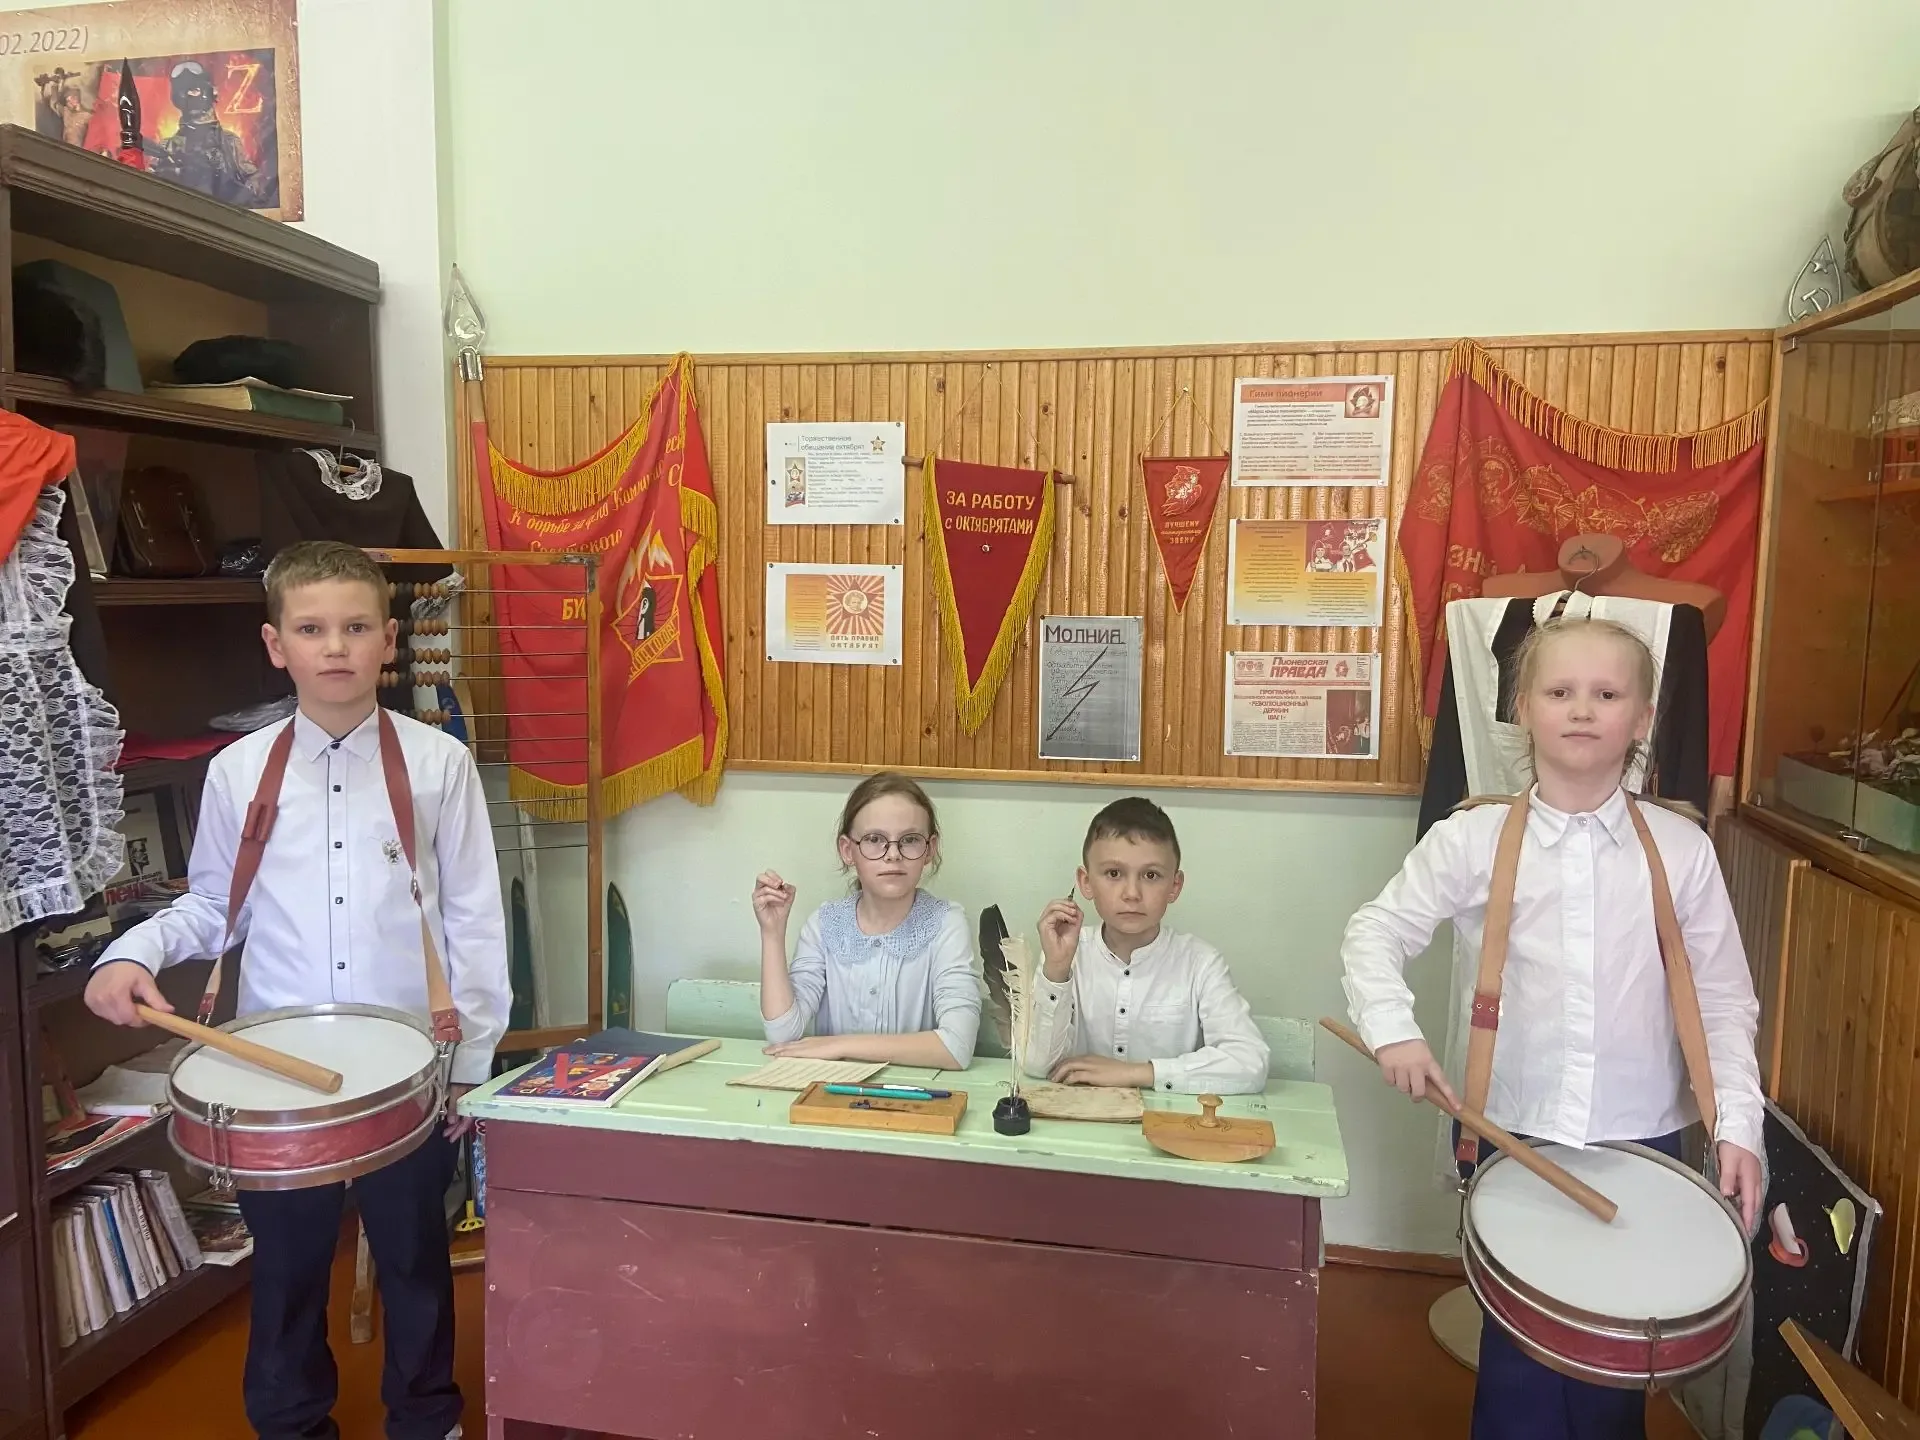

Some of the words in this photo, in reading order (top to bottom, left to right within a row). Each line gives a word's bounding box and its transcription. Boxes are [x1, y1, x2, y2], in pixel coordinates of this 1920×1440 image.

[224, 62, 263, 114] Z
[946, 490, 966, 507] ЗА
[971, 493, 1036, 511] РАБОТУ
[955, 515, 1034, 535] ОКТЯБРЯТАМИ
[1164, 520, 1200, 528] ЛУЧШЕМУ
[1272, 656, 1329, 667] Пионерская
[1269, 666, 1328, 679] ПРАВДА
